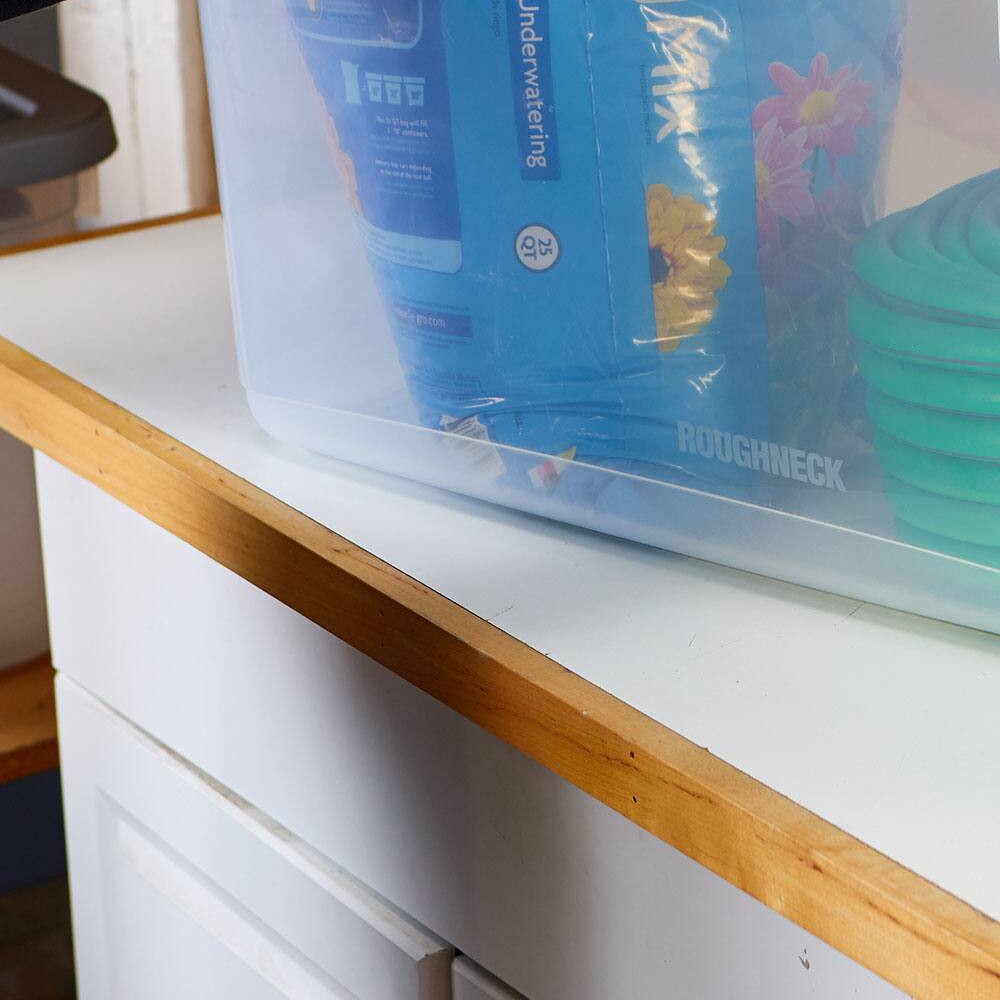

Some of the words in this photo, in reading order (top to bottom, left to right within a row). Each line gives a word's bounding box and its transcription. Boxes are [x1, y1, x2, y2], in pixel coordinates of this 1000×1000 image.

[520, 235, 537, 261] QT
[538, 238, 552, 257] 25
[676, 420, 847, 492] ROUGHNECK
